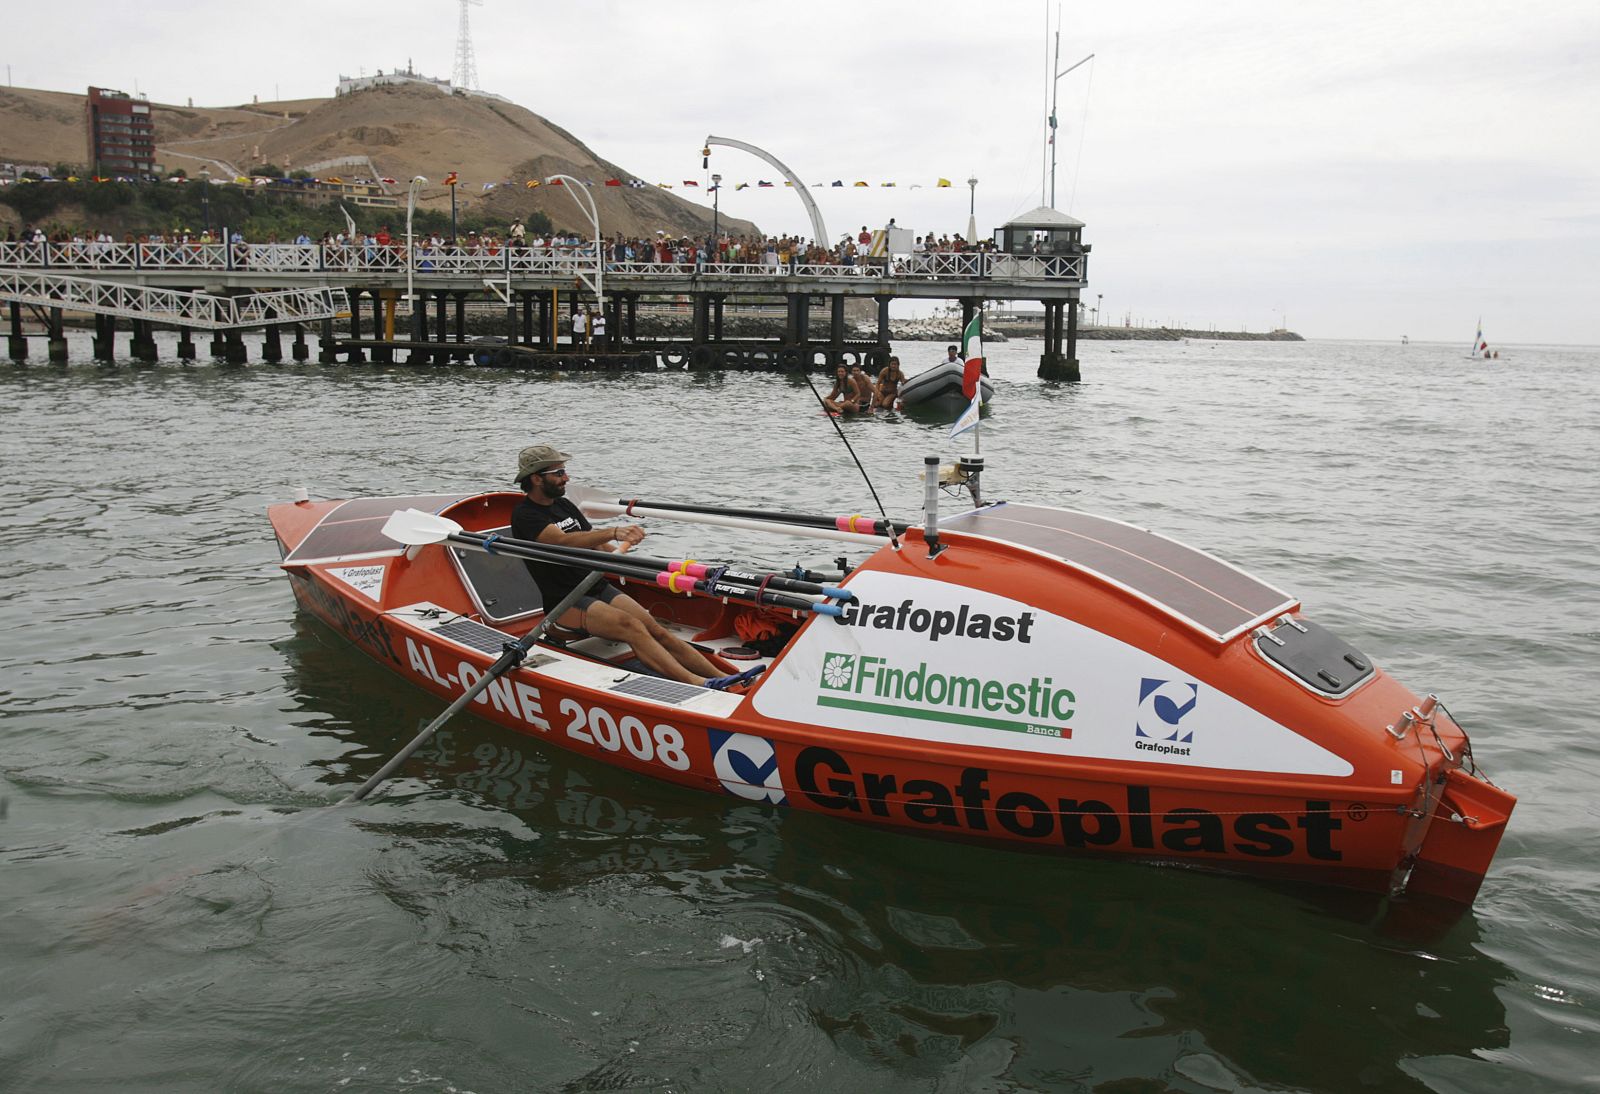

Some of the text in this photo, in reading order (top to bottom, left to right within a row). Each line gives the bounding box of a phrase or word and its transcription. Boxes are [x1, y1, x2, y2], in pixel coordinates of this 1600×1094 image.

[833, 595, 1035, 644] Grafoplast
[405, 636, 691, 771] AL-ONE 2008
[855, 655, 1076, 721] Findomestic
[1026, 724, 1061, 737] Banca
[1135, 740, 1191, 756] Grafoplast
[794, 745, 1343, 862] Grafoplast
